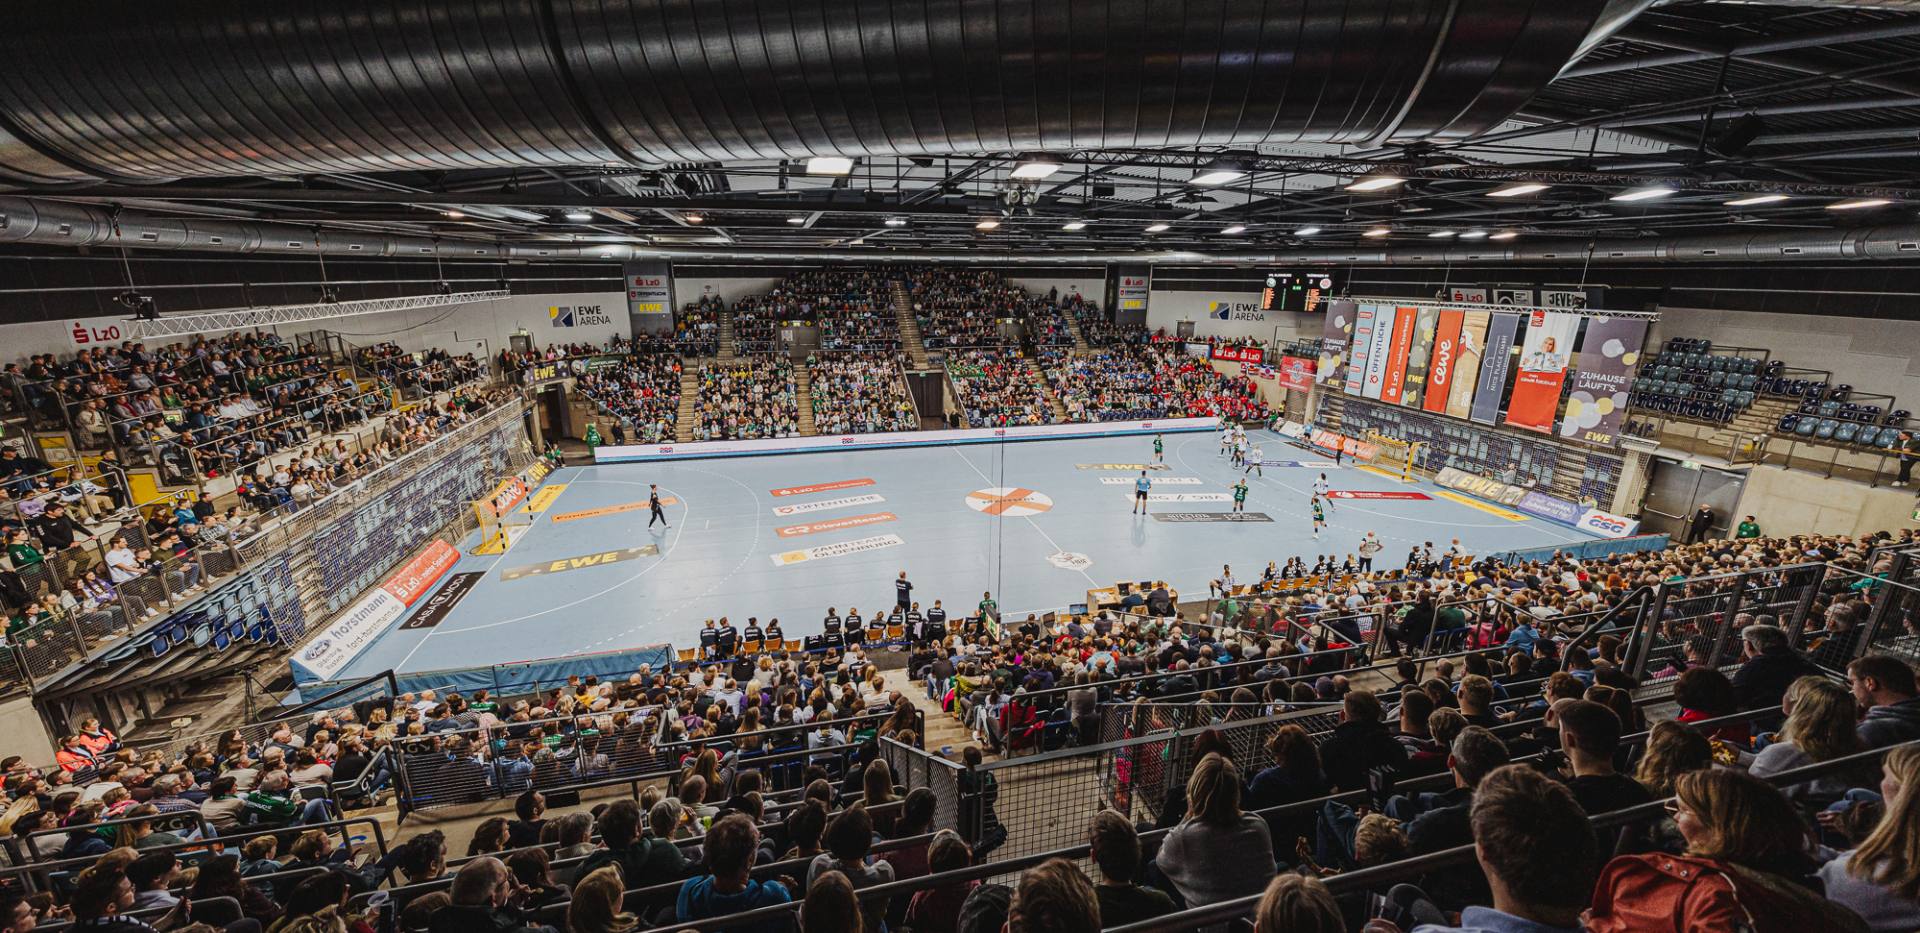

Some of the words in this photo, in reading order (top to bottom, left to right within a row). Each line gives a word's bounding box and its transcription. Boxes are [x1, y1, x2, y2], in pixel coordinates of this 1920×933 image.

[1466, 294, 1483, 303] LzO
[578, 305, 602, 315] EWE
[640, 304, 663, 312] EWE
[1236, 304, 1258, 312] EWE
[580, 315, 611, 326] ARENA
[1234, 313, 1264, 321] ARENA
[92, 326, 120, 341] LzO
[1434, 339, 1452, 385] cewe
[534, 366, 555, 380] EWE
[1580, 371, 1626, 384] ZUHAUSE
[1584, 431, 1612, 444] EWE
[528, 461, 550, 481] EWE
[813, 514, 891, 530] CleverReach
[1588, 518, 1624, 533] GSG
[814, 539, 898, 558] OLDENBURG
[550, 551, 618, 573] EWE
[331, 592, 388, 640] horstmann
